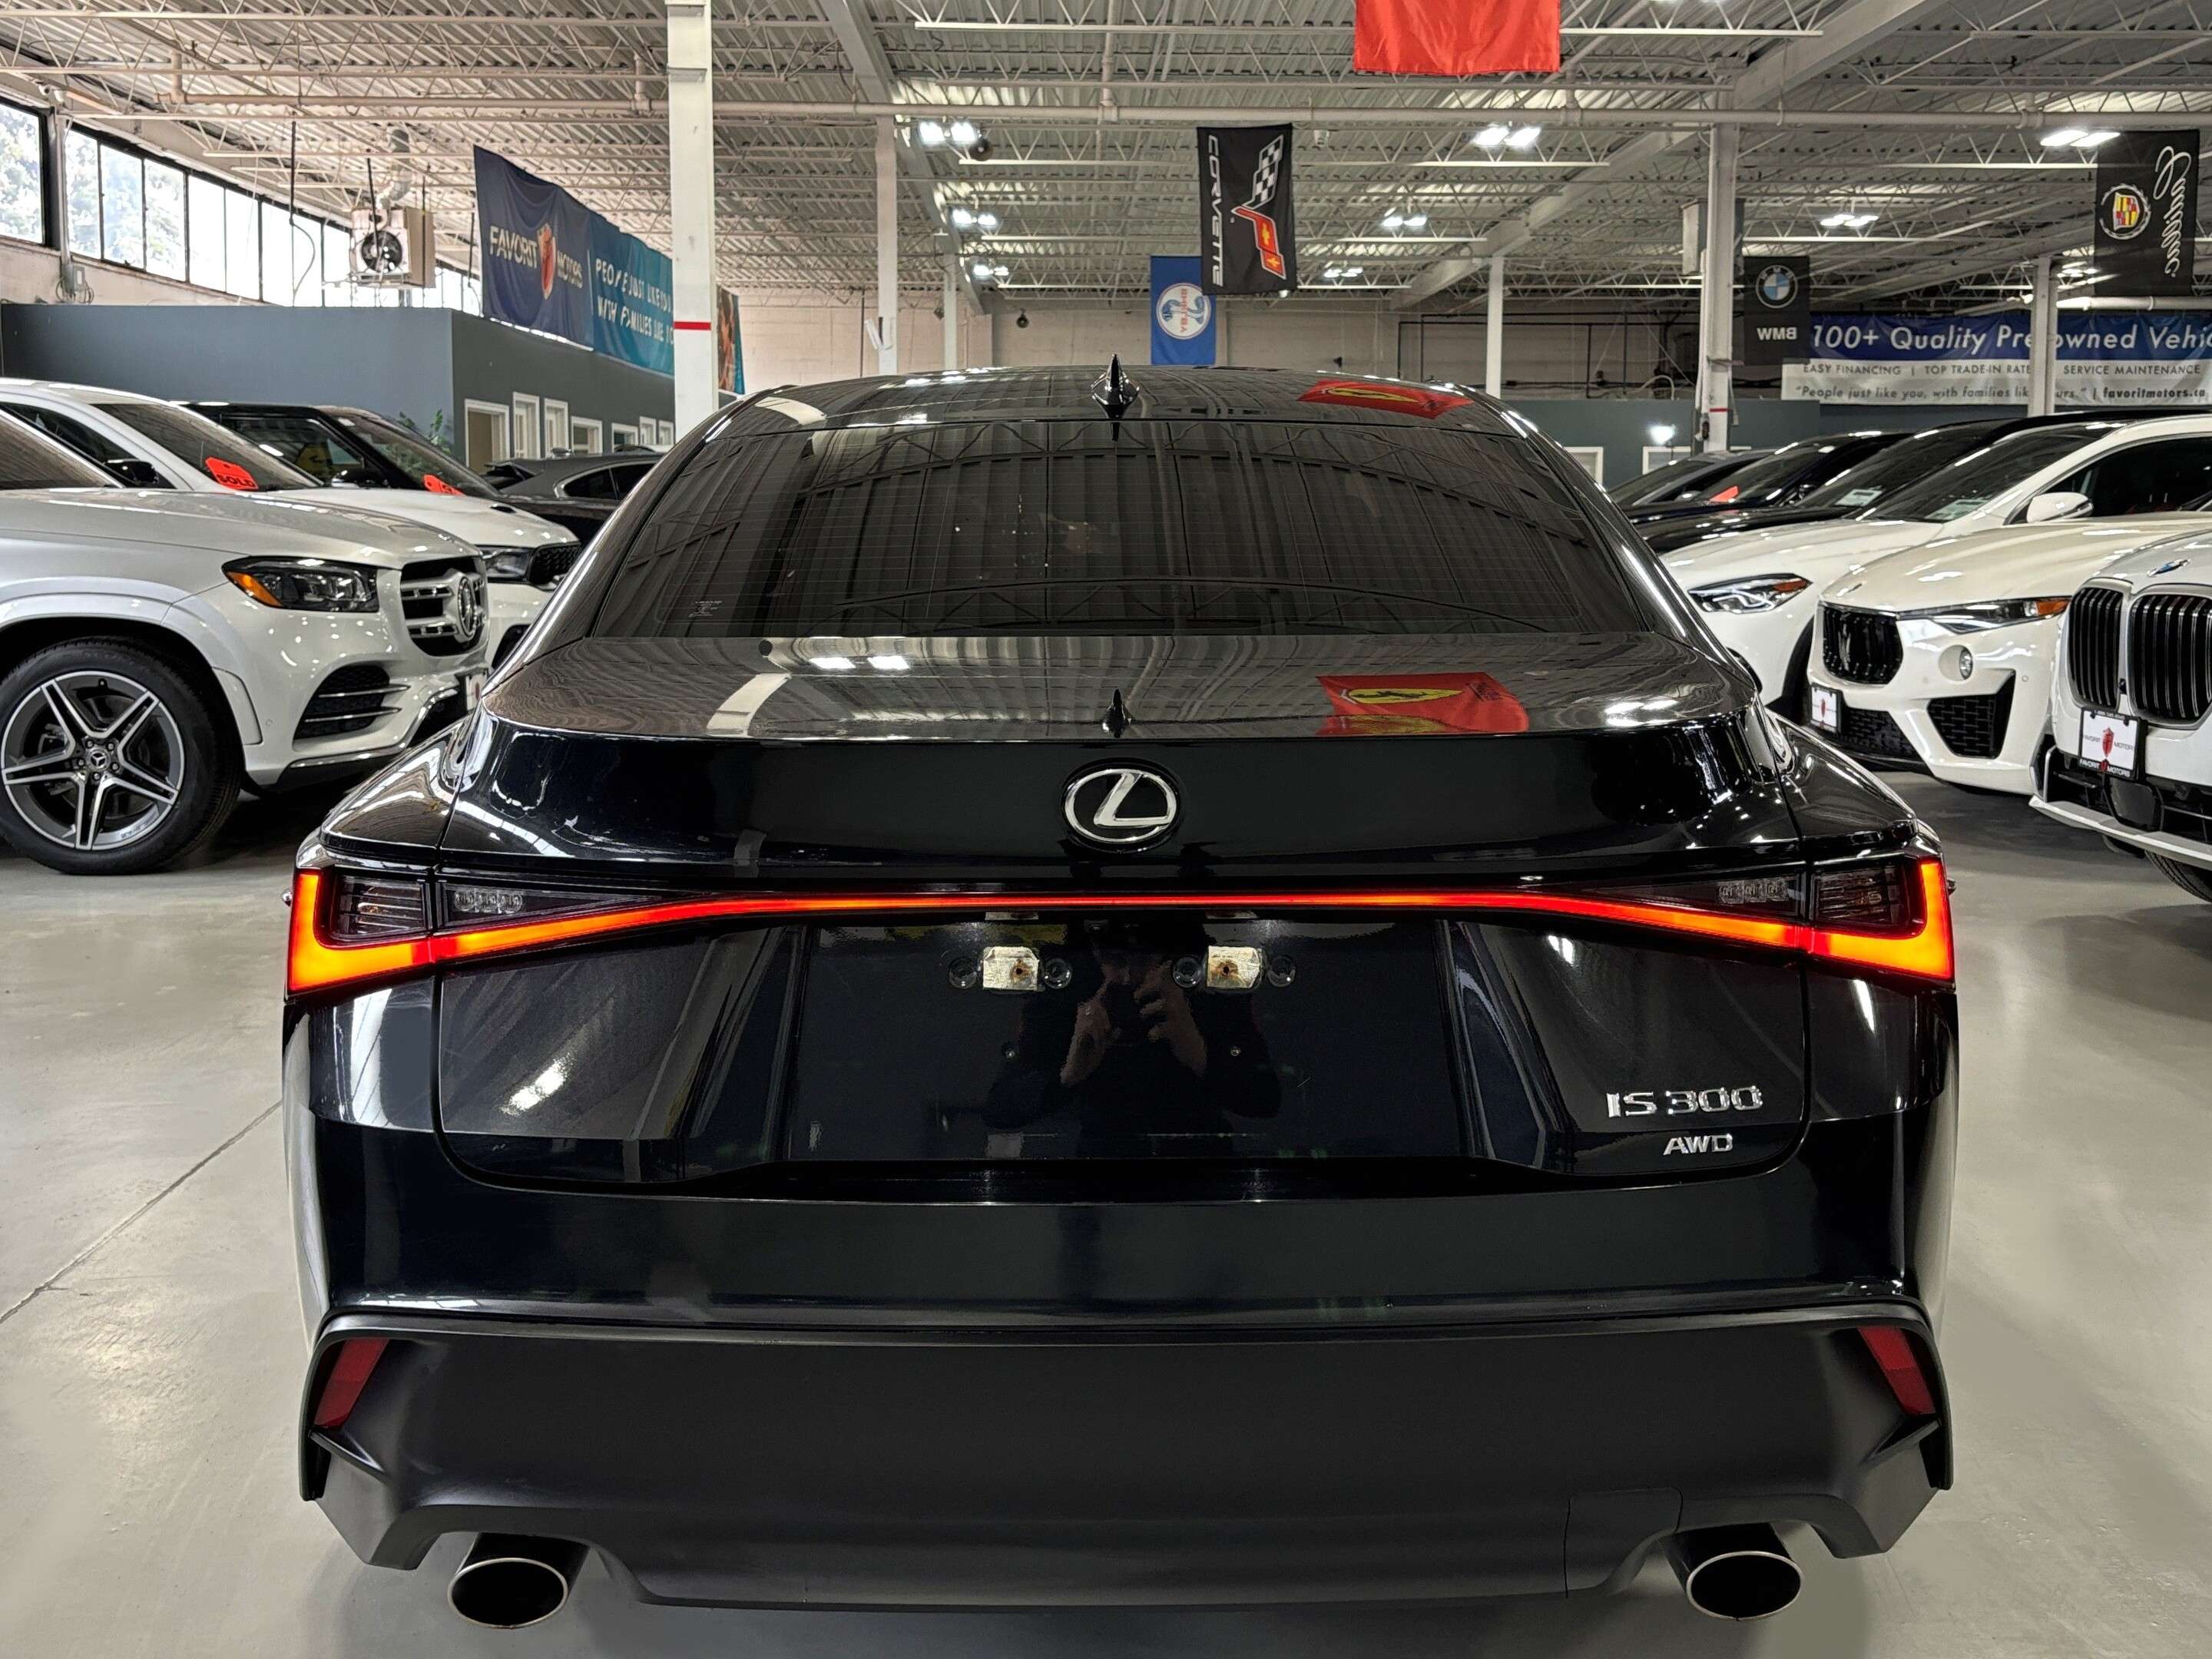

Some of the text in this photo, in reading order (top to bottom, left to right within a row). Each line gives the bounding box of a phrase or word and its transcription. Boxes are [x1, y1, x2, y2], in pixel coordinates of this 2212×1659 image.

[1208, 134, 1224, 287] CORVETTE
[489, 226, 538, 269] FAVORIT
[1813, 324, 1879, 349] 100+
[1890, 324, 1987, 356] Quality
[1803, 364, 2201, 375] EASY FINANCING TOP TRADE-IN RATE SERVICE MAINTENANCE
[1848, 386, 1872, 399] just
[1876, 386, 1898, 398] like
[1933, 386, 1958, 398] with
[1962, 386, 2010, 398] families
[2015, 386, 2028, 398] lik
[2103, 386, 2206, 399] favoritmotors.ca
[216, 473, 256, 488] SOLD
[1607, 1084, 1763, 1118] IS 300
[1663, 1132, 1734, 1156] AWD
